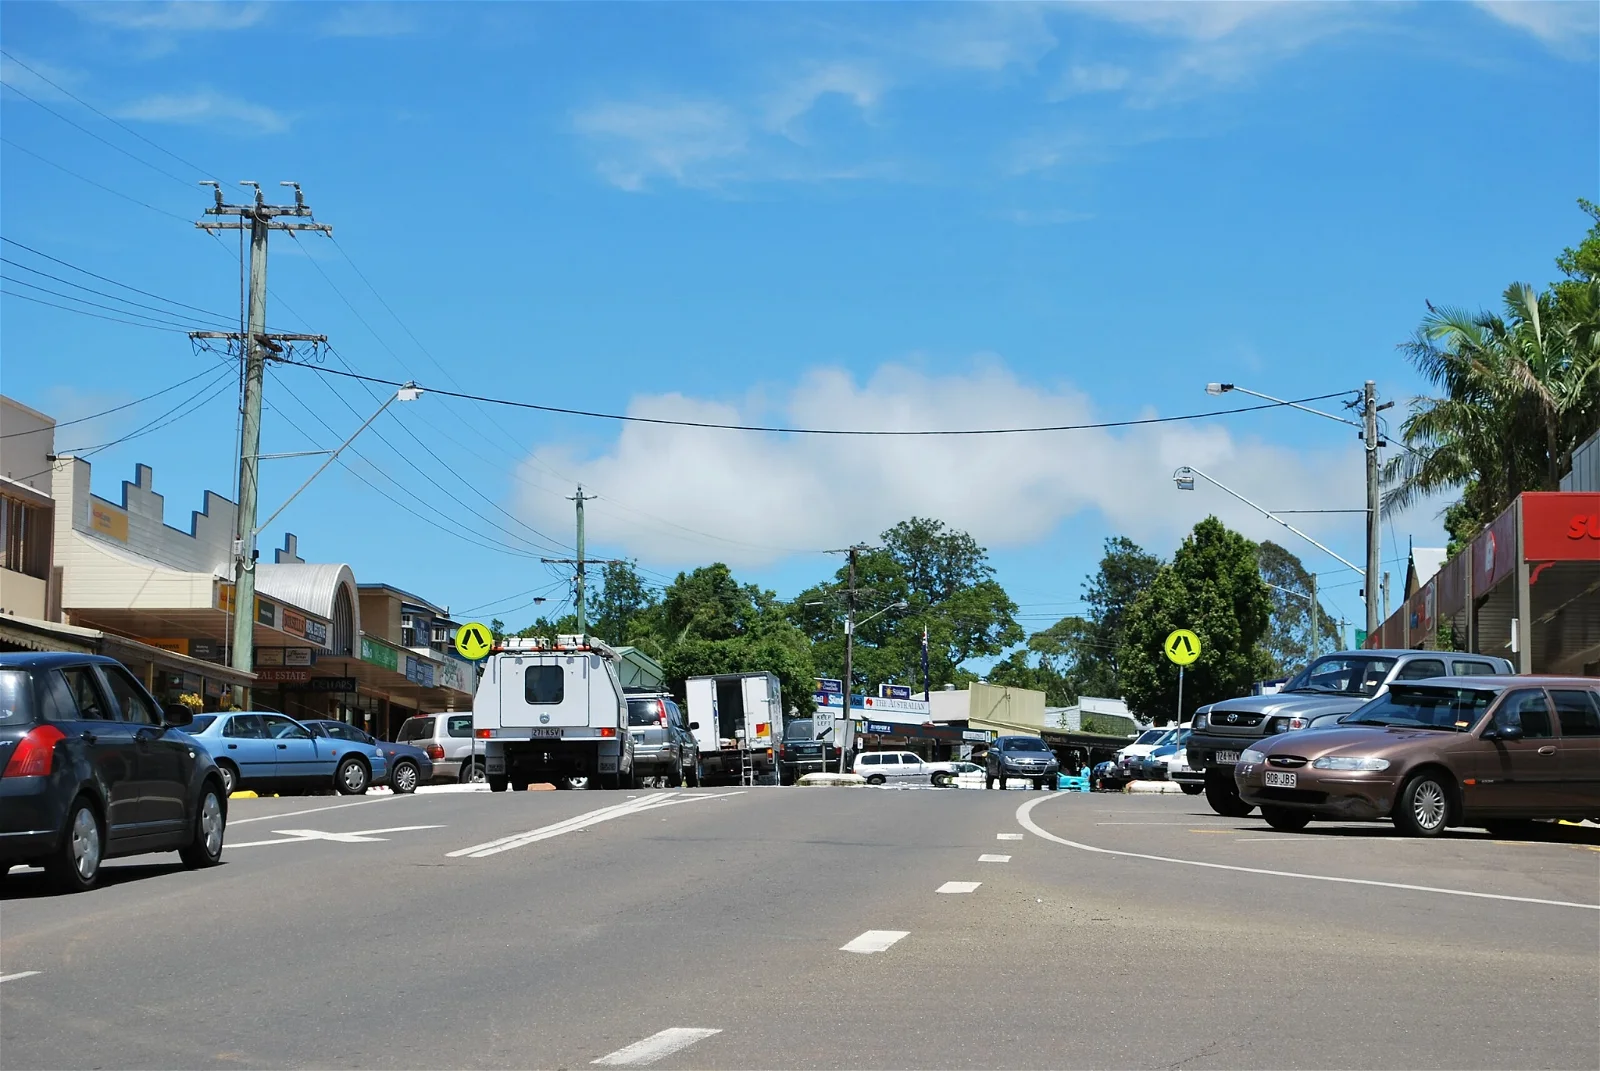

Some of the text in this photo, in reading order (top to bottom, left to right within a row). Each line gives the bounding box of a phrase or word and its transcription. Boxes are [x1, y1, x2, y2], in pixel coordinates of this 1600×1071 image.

[257, 671, 307, 680] EAL ESTATE
[828, 695, 844, 705] Sund
[876, 699, 925, 710] THE AUSTRALIAN
